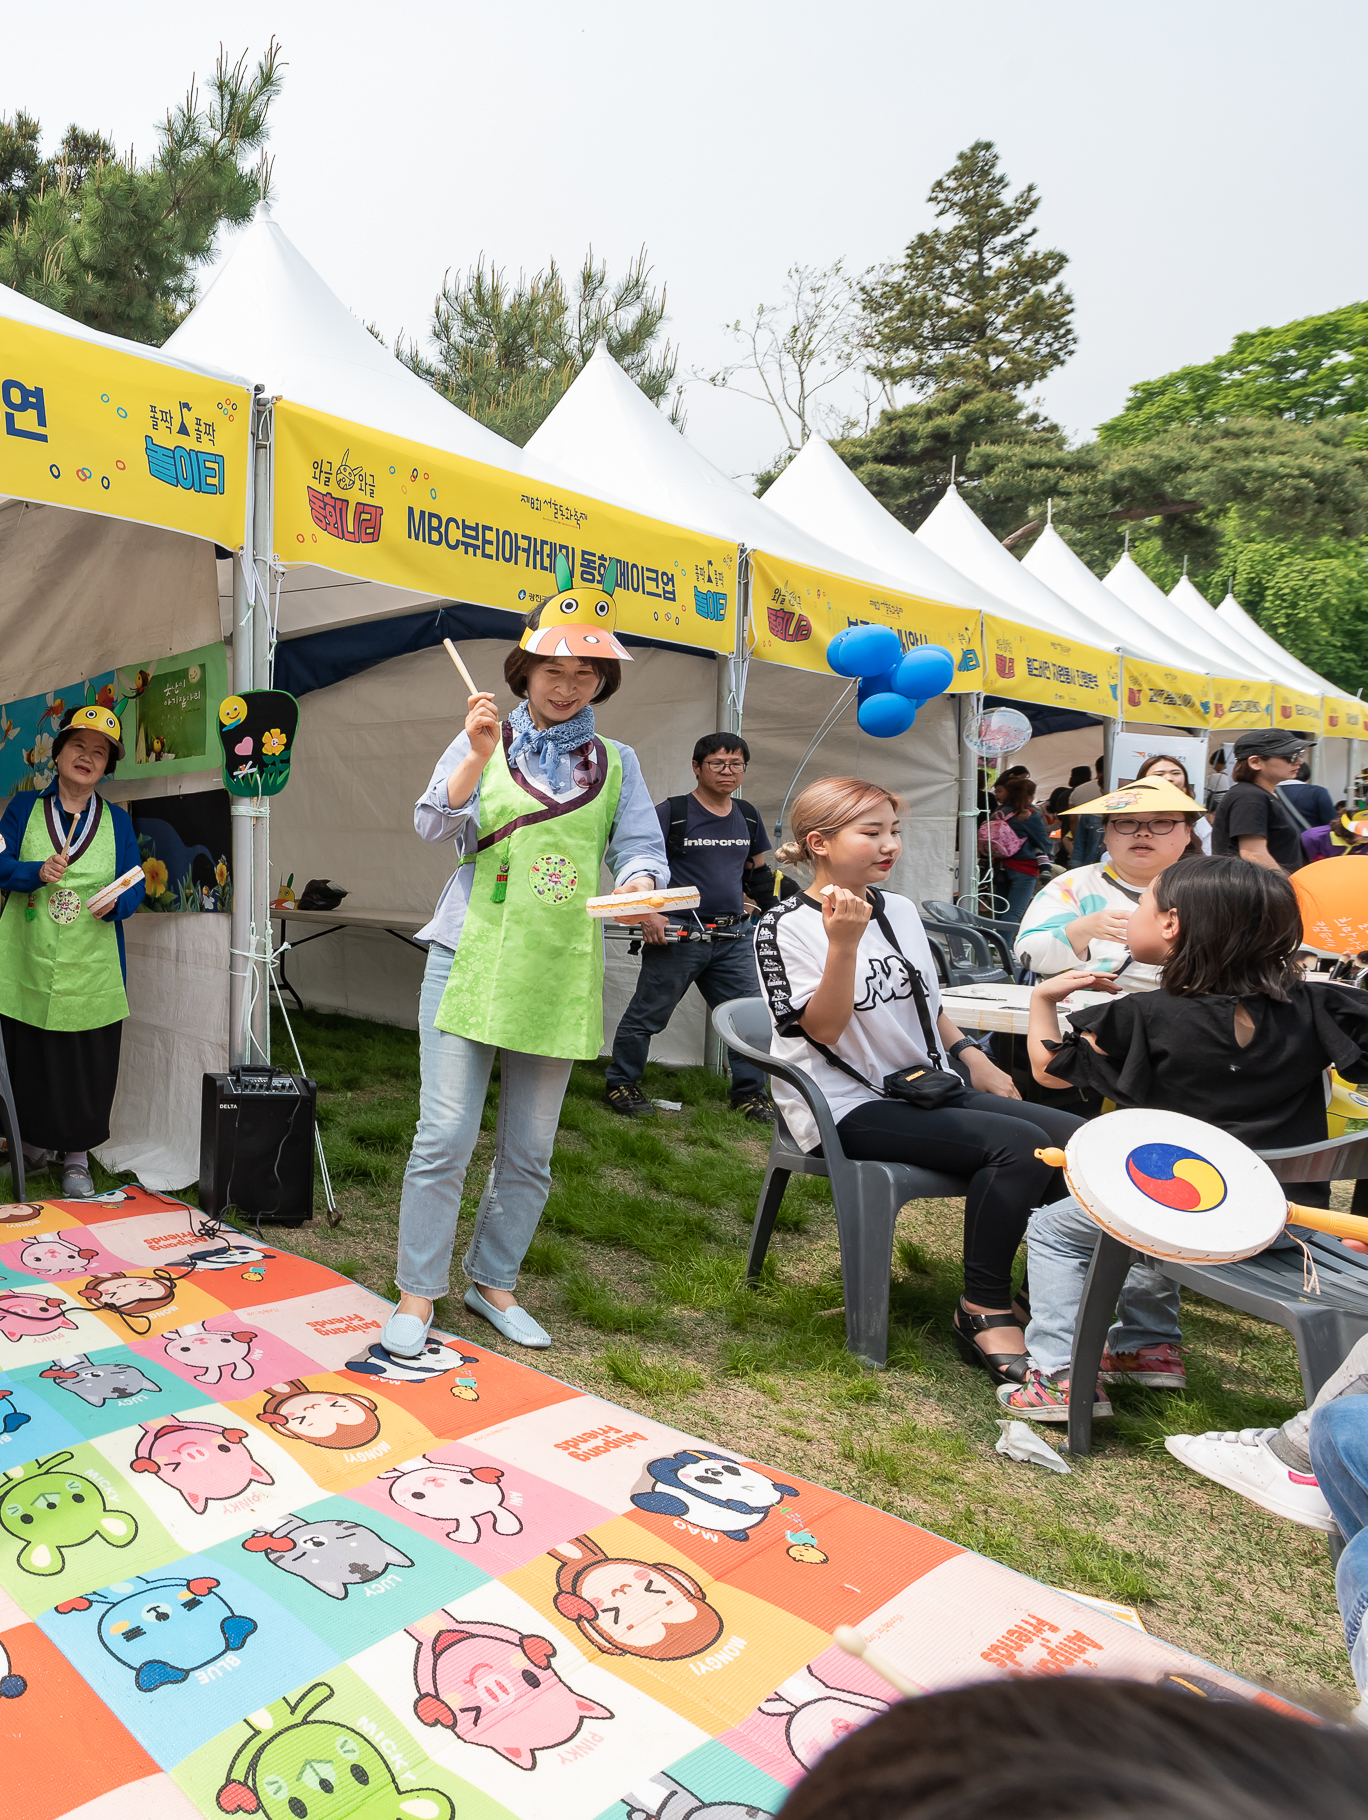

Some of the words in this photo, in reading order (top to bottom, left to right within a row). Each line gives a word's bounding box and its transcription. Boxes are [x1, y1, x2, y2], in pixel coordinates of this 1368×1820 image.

[145, 435, 224, 495] 놀이터
[312, 459, 333, 487] 와글
[358, 472, 375, 498] 와글
[528, 593, 546, 602] 광진
[694, 585, 727, 621] 놀이터
[684, 837, 751, 847] intercrew
[143, 1230, 199, 1245] Friends
[148, 1236, 208, 1252] Anipang
[306, 1312, 370, 1330] Friends
[312, 1318, 383, 1337] Anipang
[33, 1332, 66, 1345] PINKY
[369, 1374, 402, 1386] MAO
[116, 1394, 149, 1409] LUCY
[553, 1424, 622, 1452] Friends
[568, 1430, 649, 1463] Anipang
[343, 1440, 391, 1464] MONGYI
[84, 1468, 121, 1503] MICKY
[508, 1490, 524, 1506] ANI
[223, 1490, 262, 1515] PINKY
[673, 1519, 720, 1543] MAO
[363, 1573, 403, 1598] LUCY
[980, 1613, 1061, 1669] Friends
[688, 1635, 748, 1676] MONGYI
[194, 1654, 243, 1686] BLUE
[356, 1714, 417, 1782] MICKY
[557, 1732, 605, 1766] PINKY
